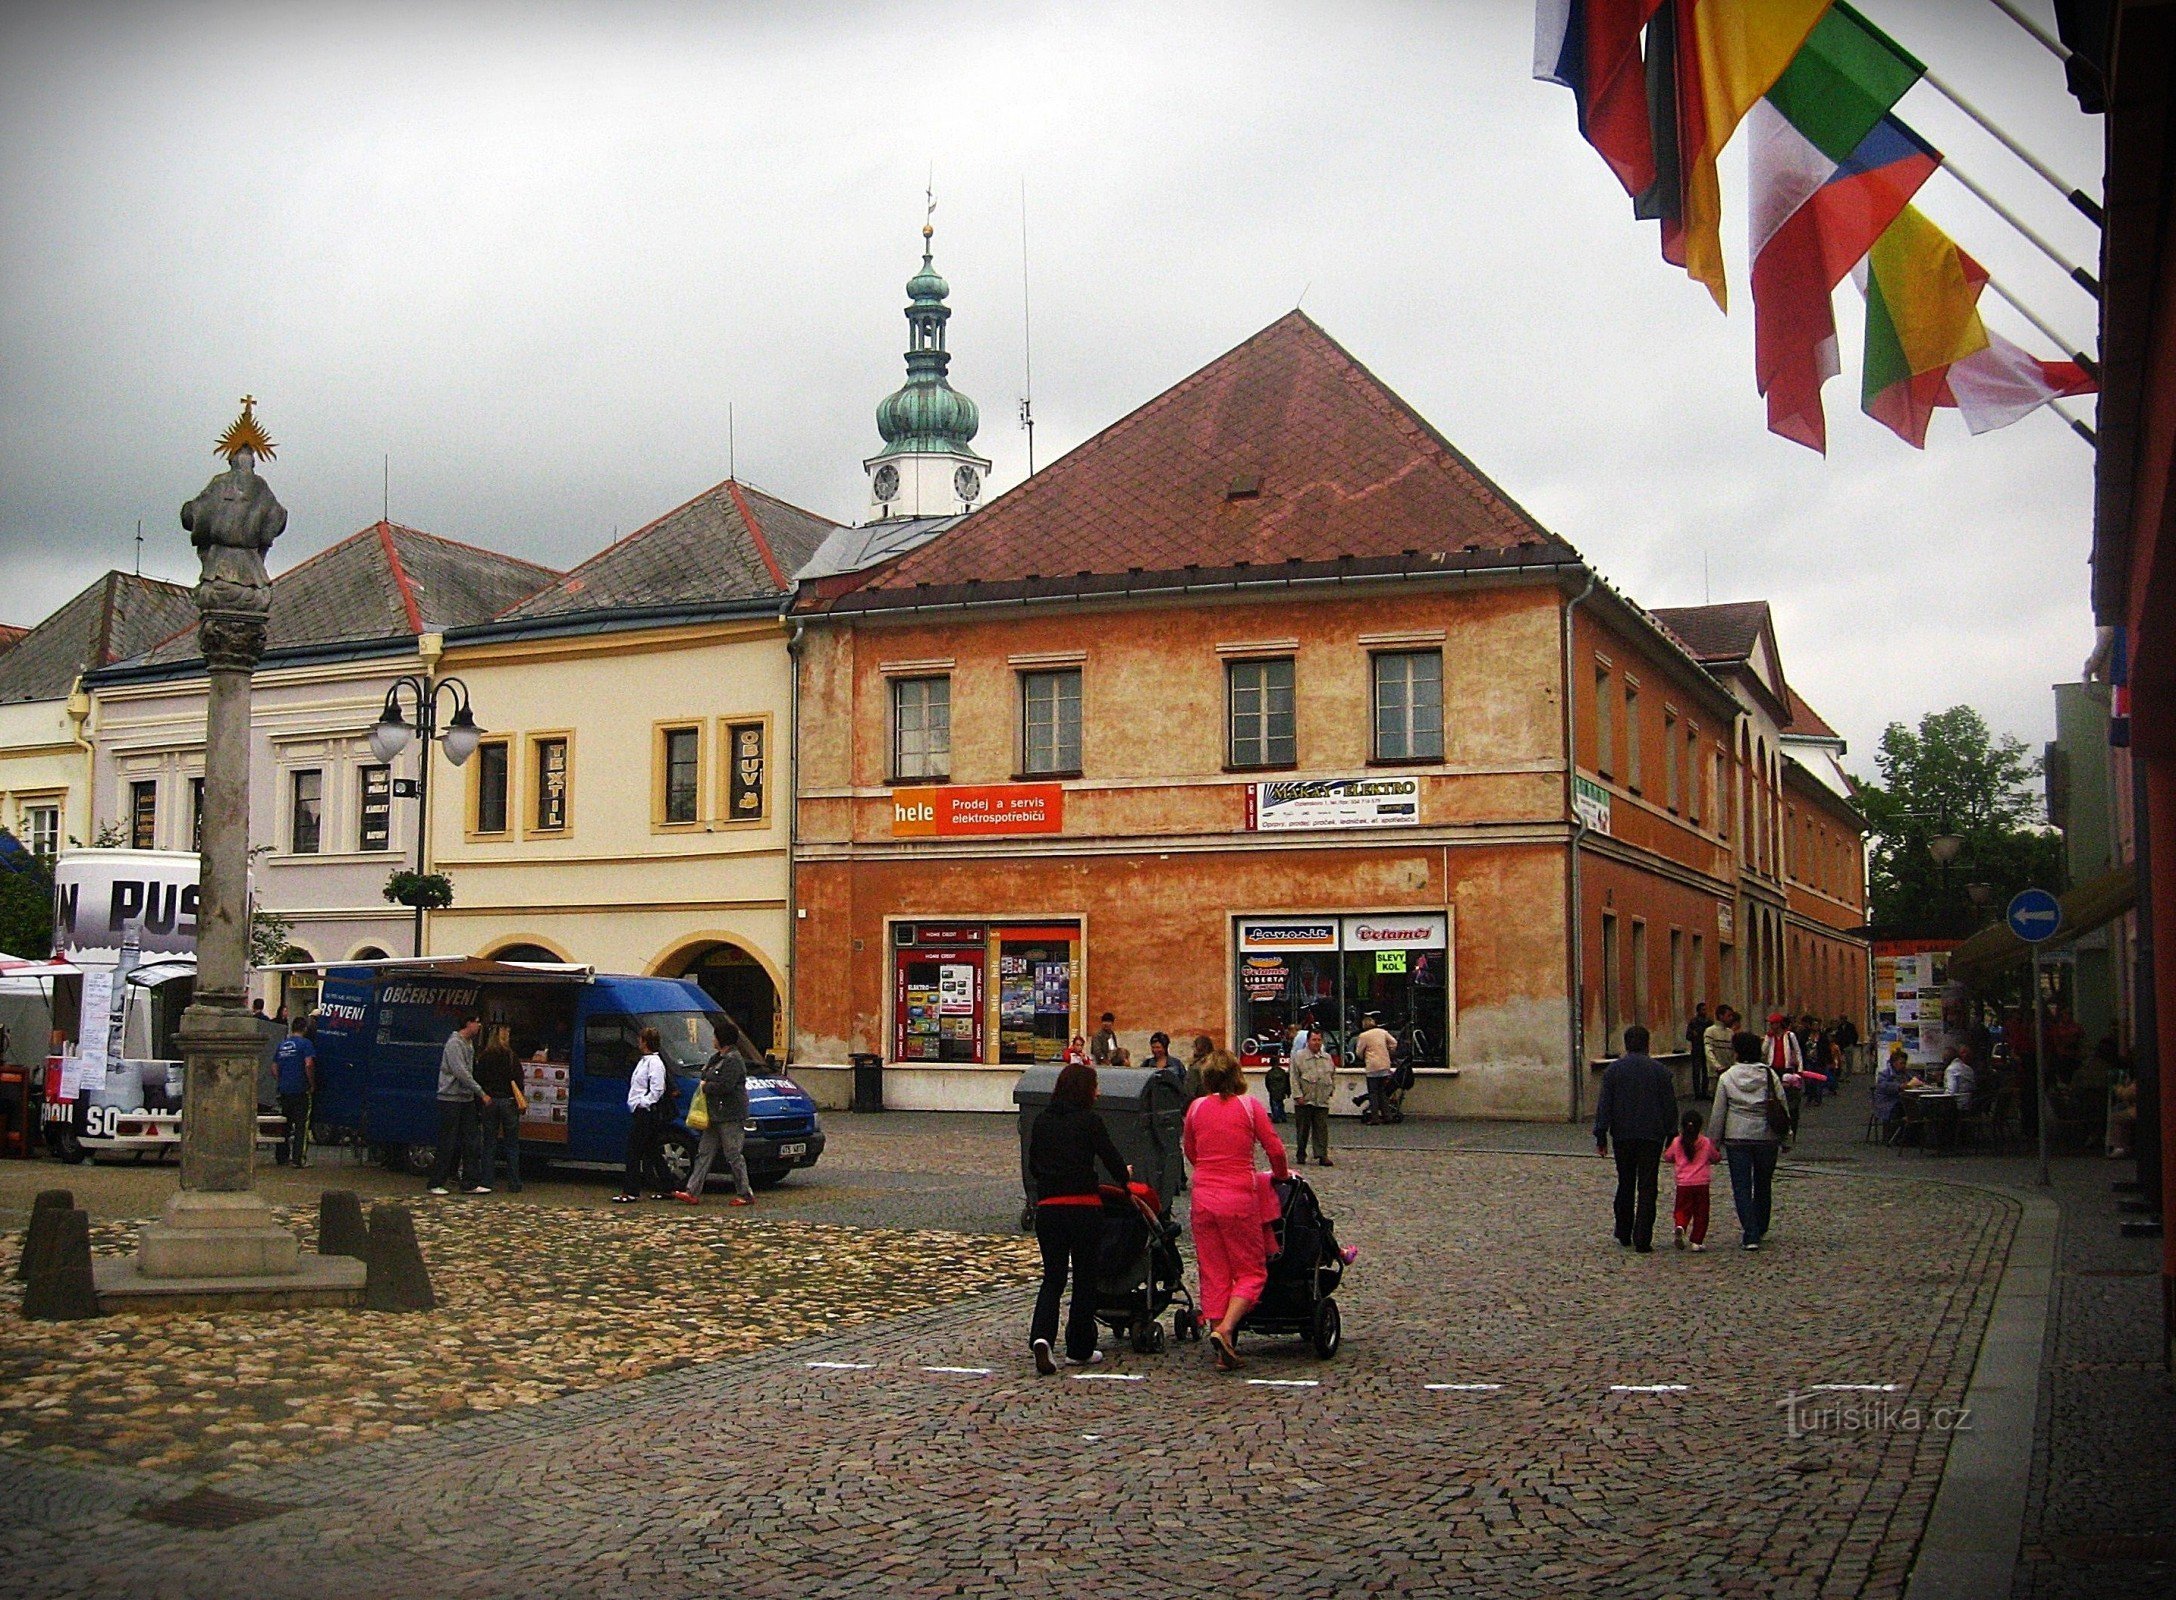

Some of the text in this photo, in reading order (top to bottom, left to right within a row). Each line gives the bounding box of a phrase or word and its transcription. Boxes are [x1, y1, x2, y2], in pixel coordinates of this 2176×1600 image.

[741, 730, 759, 786] OBUV
[547, 744, 565, 826] TEXTIL
[1273, 785, 1332, 799] MAKAY
[1343, 781, 1416, 797] ELEKTRO
[895, 802, 934, 822] hele
[952, 797, 1045, 811] Prodej a servis
[952, 811, 1045, 824] elektrospotřebičů
[1377, 953, 1405, 962] SLEVY
[1382, 962, 1400, 971] KOL
[382, 982, 483, 1006] OBČERSTVENÍ
